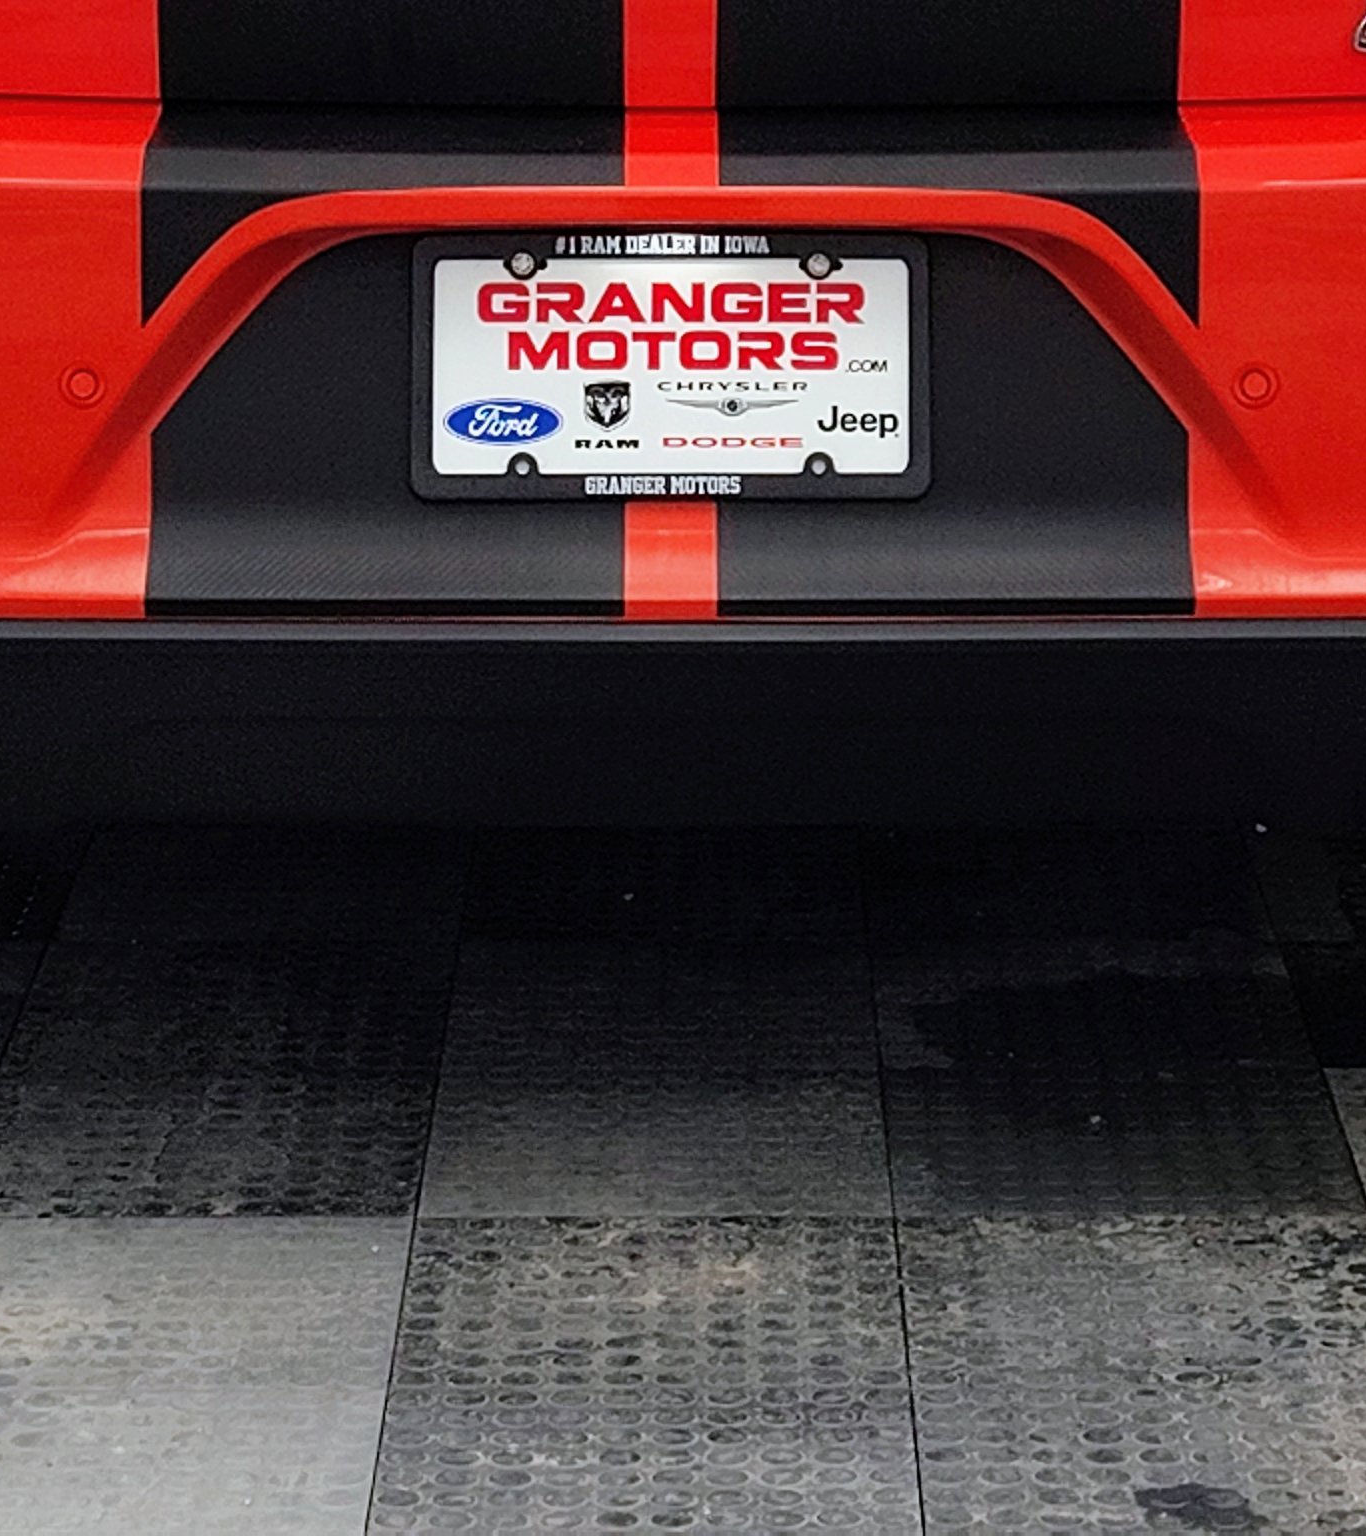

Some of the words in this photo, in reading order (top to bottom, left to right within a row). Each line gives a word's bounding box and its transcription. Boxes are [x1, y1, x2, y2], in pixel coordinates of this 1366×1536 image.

[580, 235, 622, 254] RAM
[624, 234, 696, 255] DEALER
[699, 235, 720, 255] IN
[724, 235, 770, 254] IOWA
[477, 281, 865, 324] GRANGER
[507, 330, 840, 371] MOTORS
[657, 380, 808, 392] CHRYSLER
[467, 405, 538, 438] Ford
[816, 405, 899, 439] Jeep
[574, 439, 640, 449] RAM
[662, 437, 804, 449] DODGE
[584, 476, 667, 495] GRANGER
[669, 476, 742, 495] MOTORS
